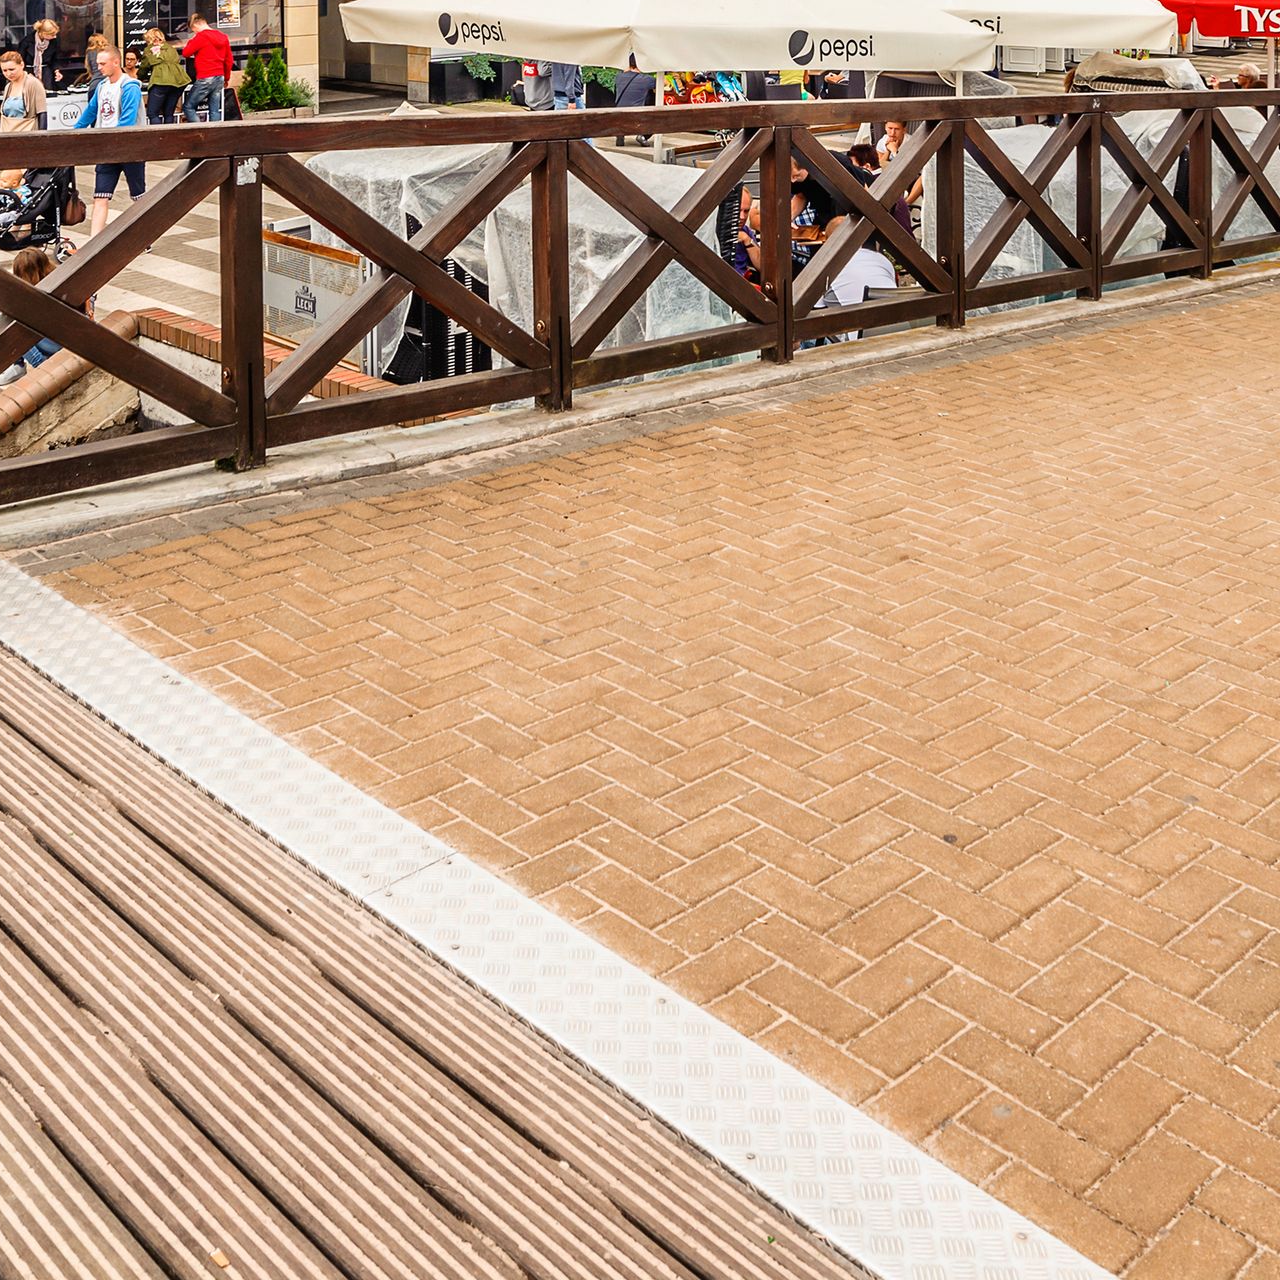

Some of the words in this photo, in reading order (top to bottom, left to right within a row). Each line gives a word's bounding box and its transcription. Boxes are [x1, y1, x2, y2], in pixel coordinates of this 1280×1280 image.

[460, 20, 504, 46] pepsi
[819, 35, 874, 63] pepsi
[296, 297, 313, 312] LECH
